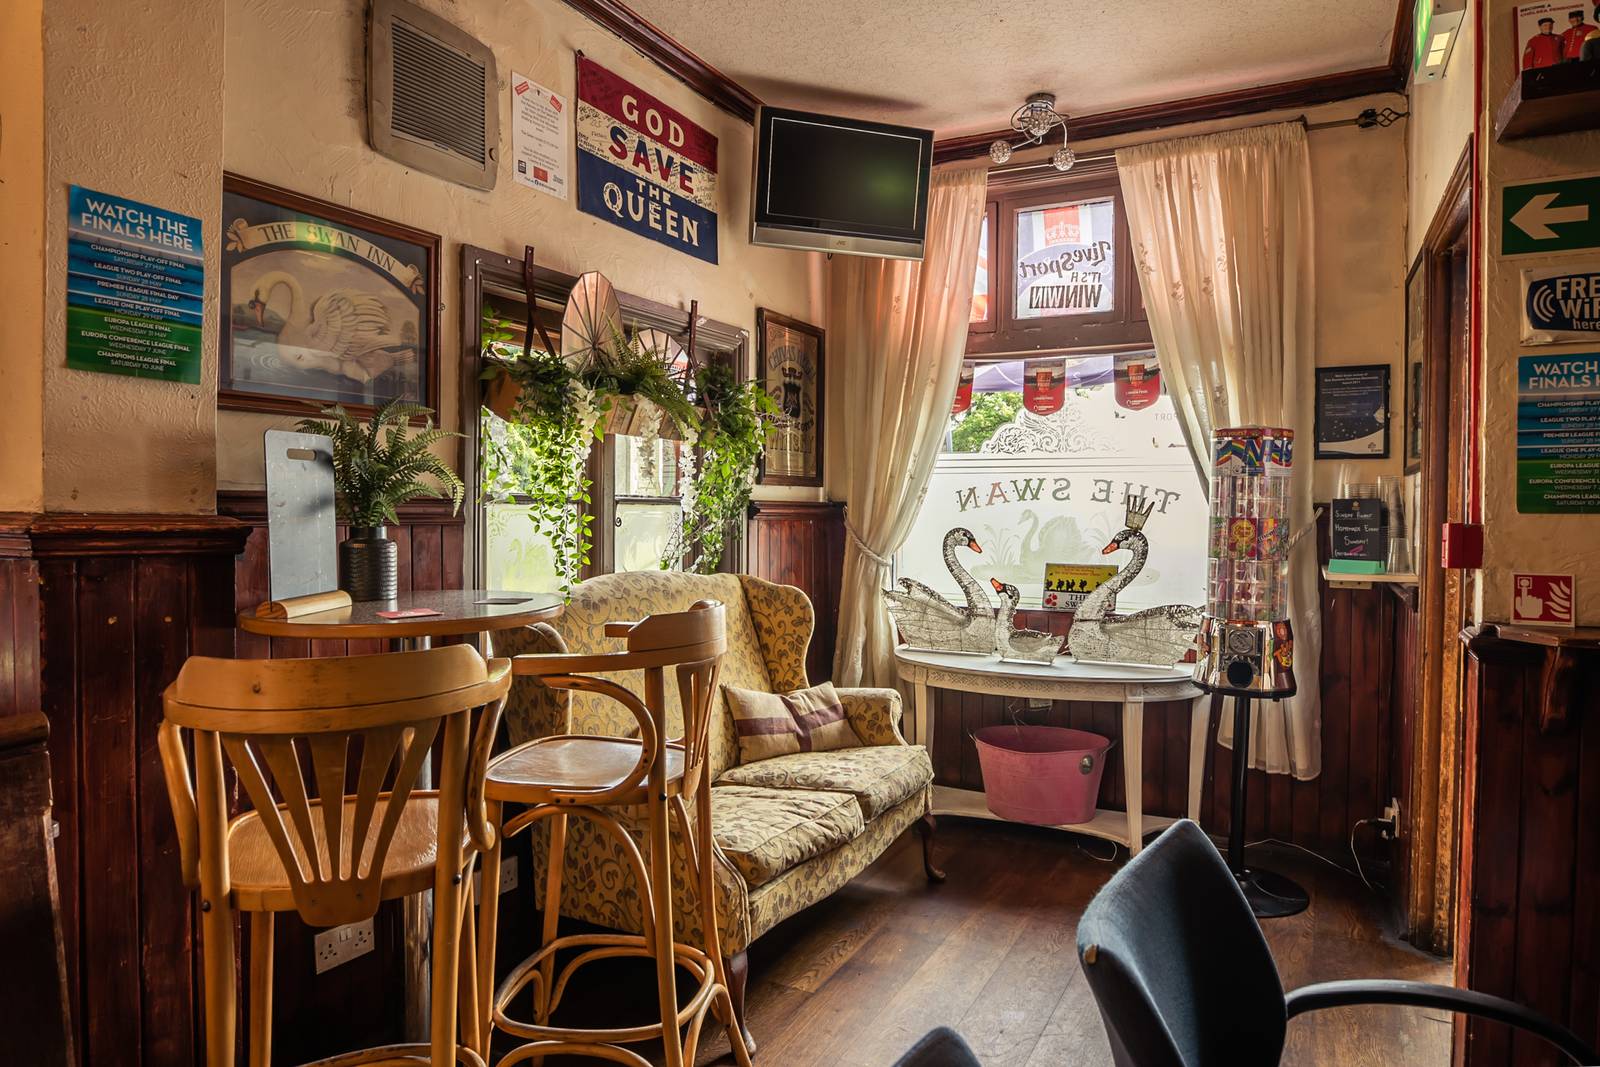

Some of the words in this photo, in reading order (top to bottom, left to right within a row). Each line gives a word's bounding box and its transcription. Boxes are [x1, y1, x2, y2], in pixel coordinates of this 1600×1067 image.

[622, 95, 684, 147] GOD
[609, 126, 693, 194] SAVE
[636, 179, 671, 206] THE
[86, 198, 152, 227] WATCH
[156, 216, 188, 237] THE
[603, 182, 699, 247] QUEEN
[82, 213, 145, 239] FINALS
[150, 229, 193, 251] HERE
[91, 244, 139, 258] CHAMPIONSHIP
[140, 255, 168, 265] PLAY-OFF
[169, 261, 185, 269] FINAL
[258, 223, 295, 241] THE
[306, 224, 360, 252] SWAN
[366, 243, 396, 272] INN
[94, 262, 120, 273] LEAGUE
[136, 271, 164, 280] PLAY-OFF
[97, 281, 124, 290] PREMIER
[125, 286, 149, 295] LEAGUE
[150, 291, 167, 299] FINAL
[94, 297, 119, 306] LEAGUE
[135, 305, 163, 314] PLAY-OFF
[104, 317, 130, 326] EUROPA
[131, 321, 154, 329] LEAGUE
[110, 325, 147, 335] WEDNESDAY
[82, 331, 107, 340] EUROPA
[108, 334, 150, 346] CONFERENCE
[151, 341, 173, 349] LEAGUE
[174, 344, 190, 352] FINAL
[109, 342, 148, 352] WEDNESDAY
[97, 351, 136, 360] CHAMPIONS
[136, 355, 160, 364] LEAGUE
[111, 360, 141, 369] SATURDAY
[1533, 360, 1598, 375] WATCH
[1529, 375, 1591, 389] FINALS
